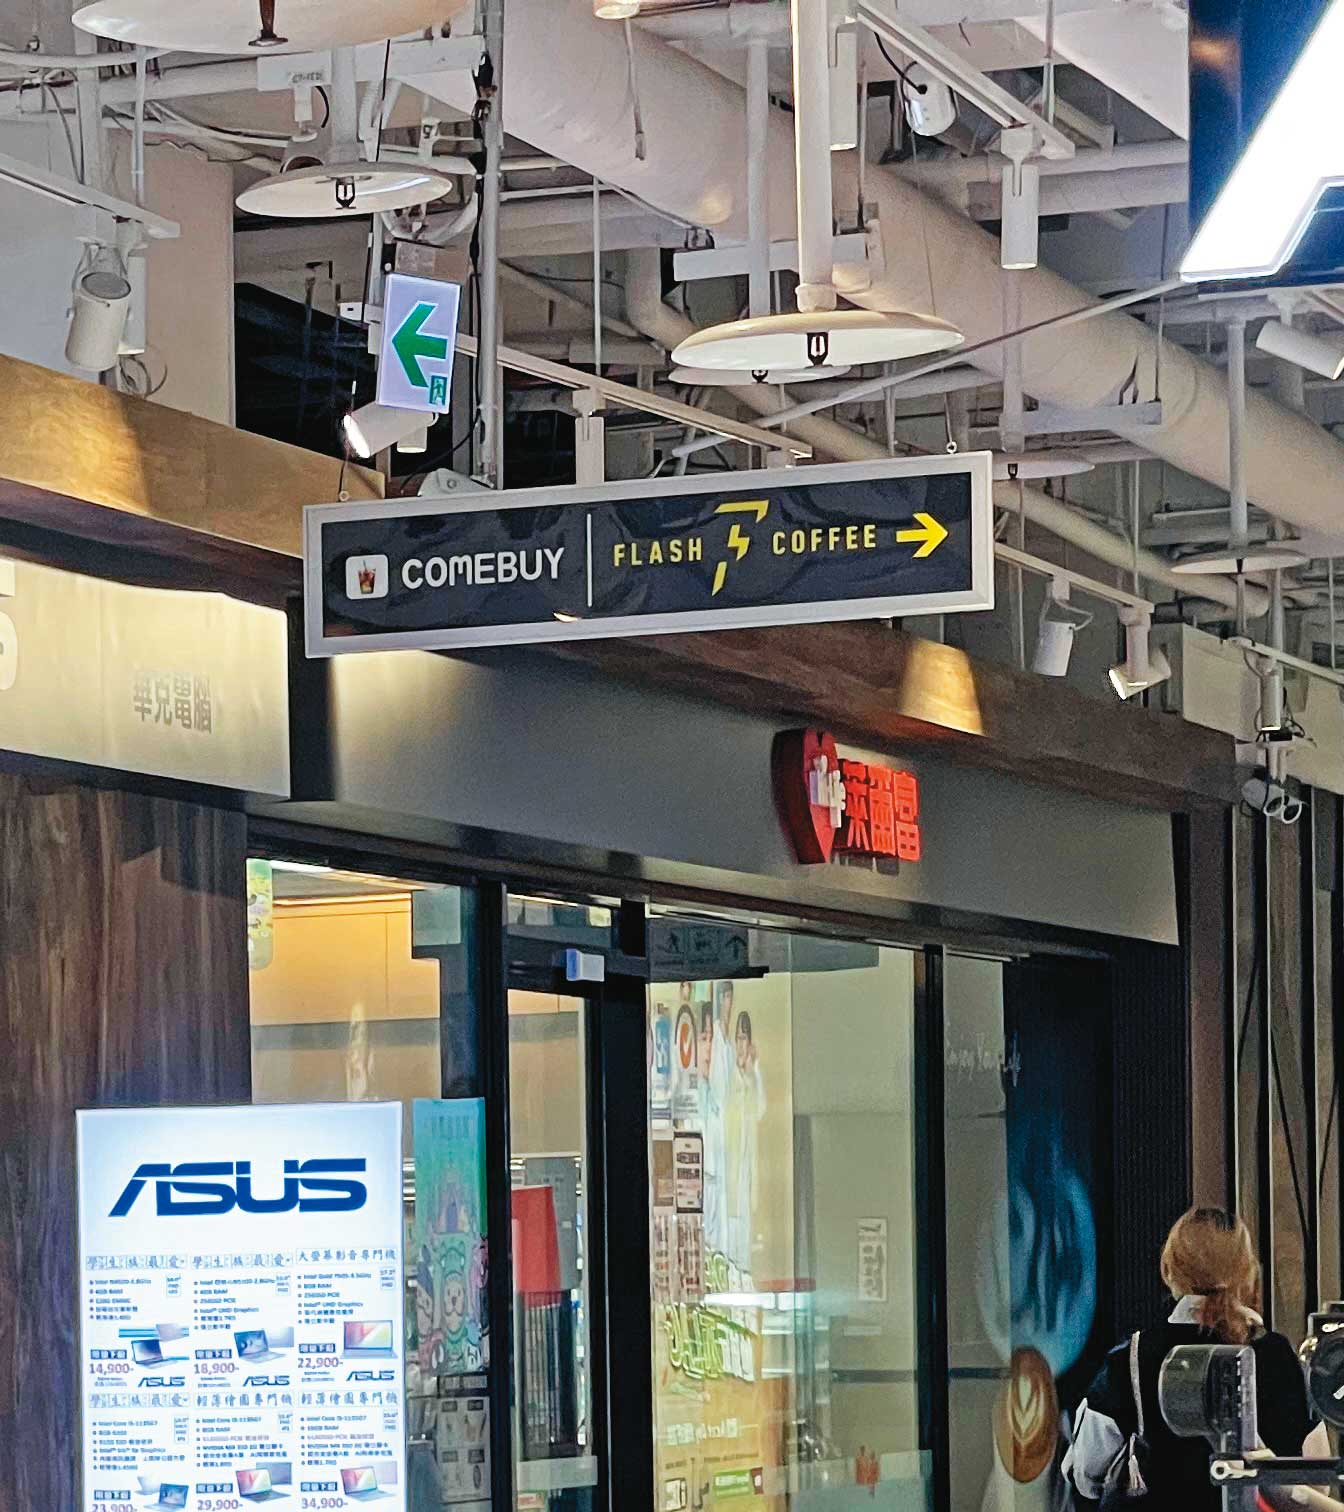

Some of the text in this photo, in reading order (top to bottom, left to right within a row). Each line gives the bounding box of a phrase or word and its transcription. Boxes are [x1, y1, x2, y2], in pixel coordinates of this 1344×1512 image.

[614, 524, 878, 568] FLASH COFFEE
[401, 546, 565, 590] COMEBUY
[108, 1157, 368, 1218] ASUS
[138, 1376, 186, 1388] ASUS
[243, 1375, 290, 1387] ASUS
[346, 1370, 395, 1382] ASUS
